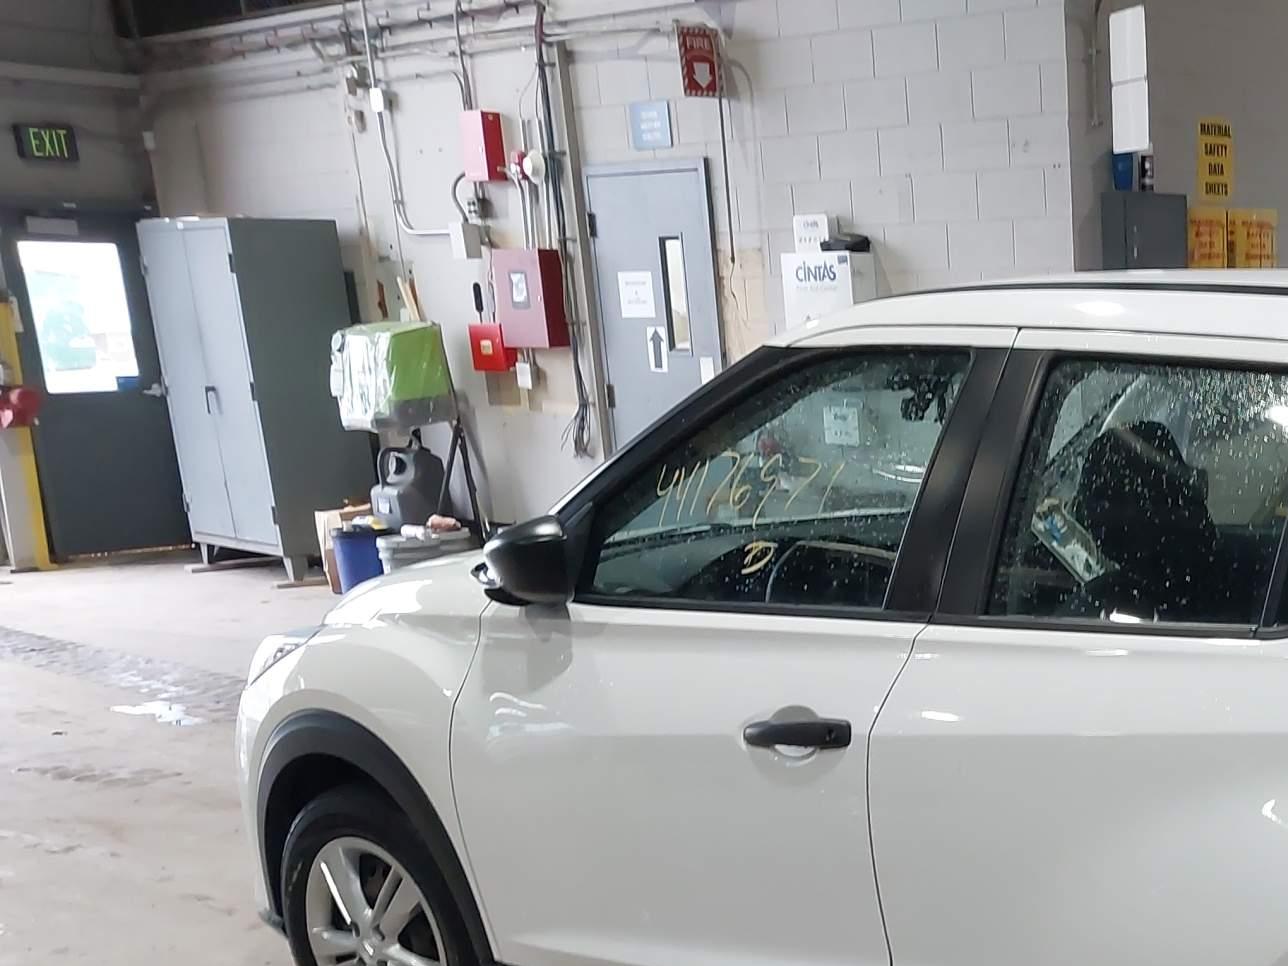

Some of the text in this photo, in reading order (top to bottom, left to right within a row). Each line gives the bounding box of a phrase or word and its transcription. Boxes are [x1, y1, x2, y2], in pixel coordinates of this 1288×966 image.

[685, 36, 711, 49] FIRE
[1199, 122, 1231, 139] MATERIAL
[28, 127, 69, 159] EXIT
[1204, 142, 1228, 158] SAFETY
[1208, 162, 1225, 177] DATA
[1205, 181, 1229, 197] SHEETS
[656, 448, 846, 530] 44176971
